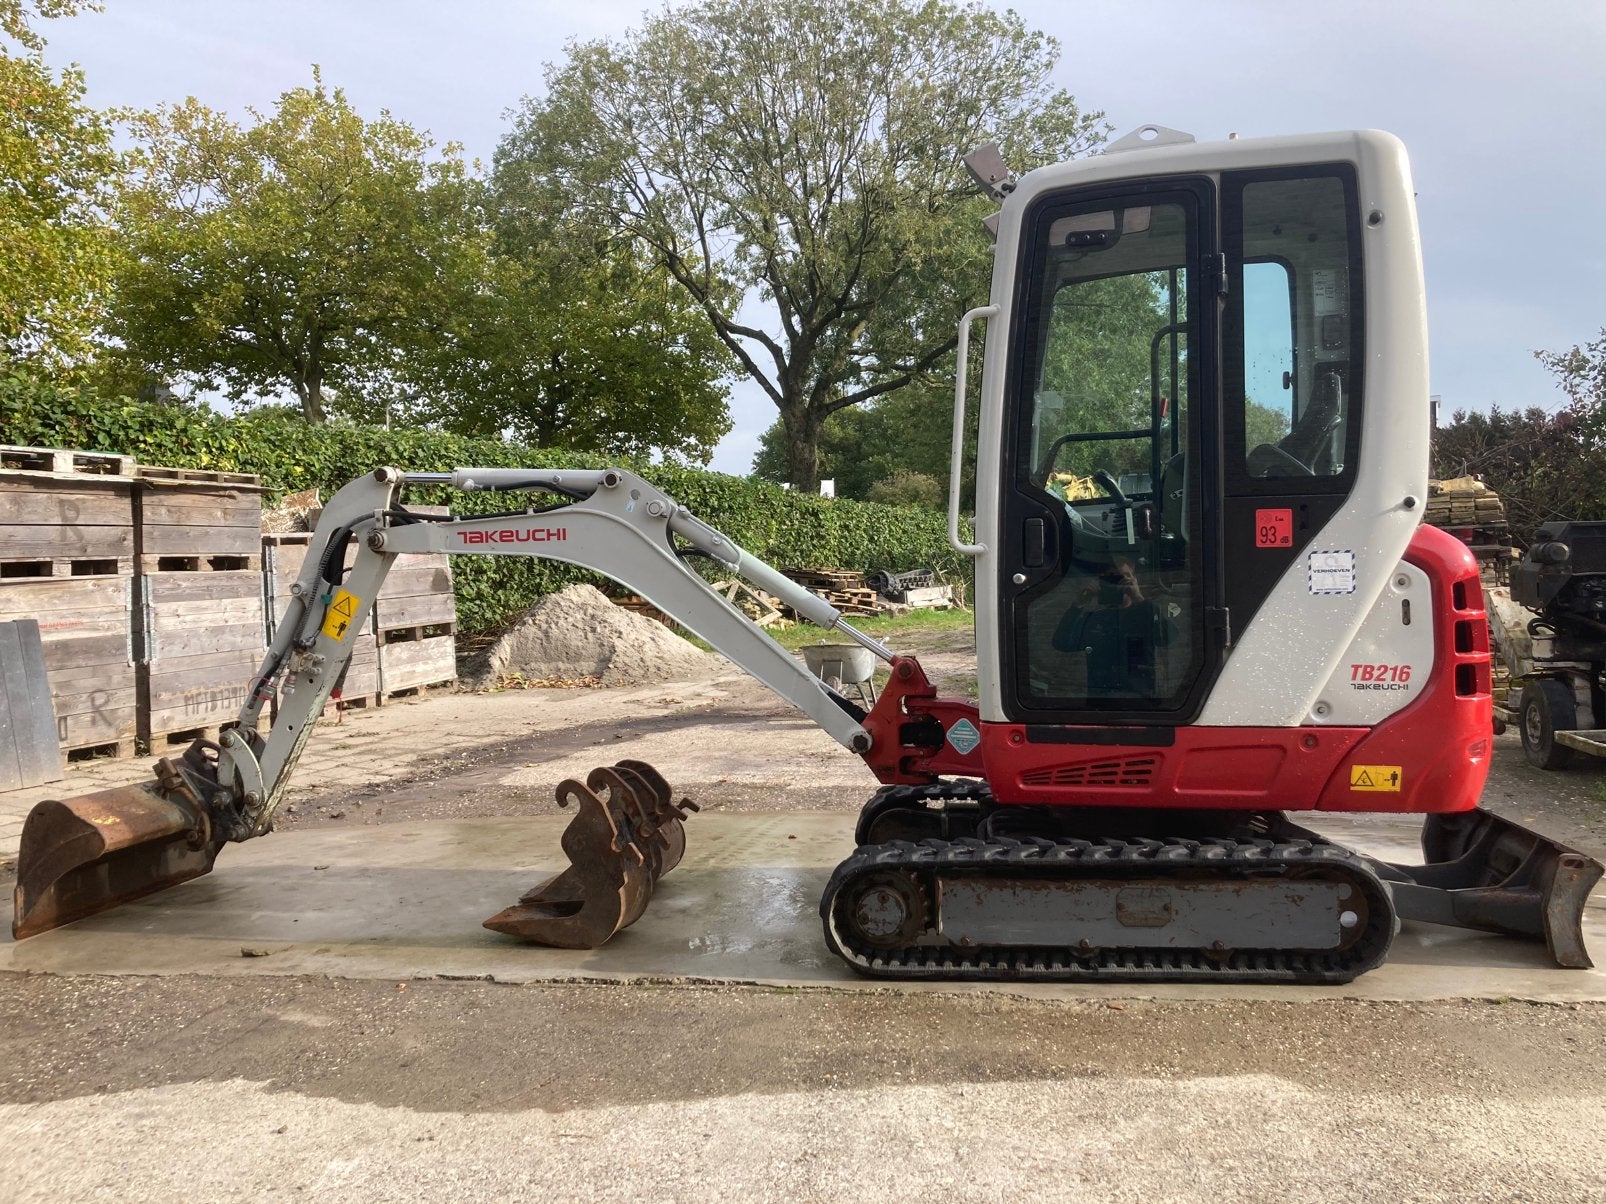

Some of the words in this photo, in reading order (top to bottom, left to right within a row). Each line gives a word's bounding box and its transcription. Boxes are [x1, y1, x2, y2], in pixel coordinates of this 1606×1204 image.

[457, 528, 567, 544] TAKEUCHI
[1260, 526, 1277, 544] 93
[1351, 664, 1412, 682] TB216
[1351, 683, 1409, 691] TAKEUCHI
